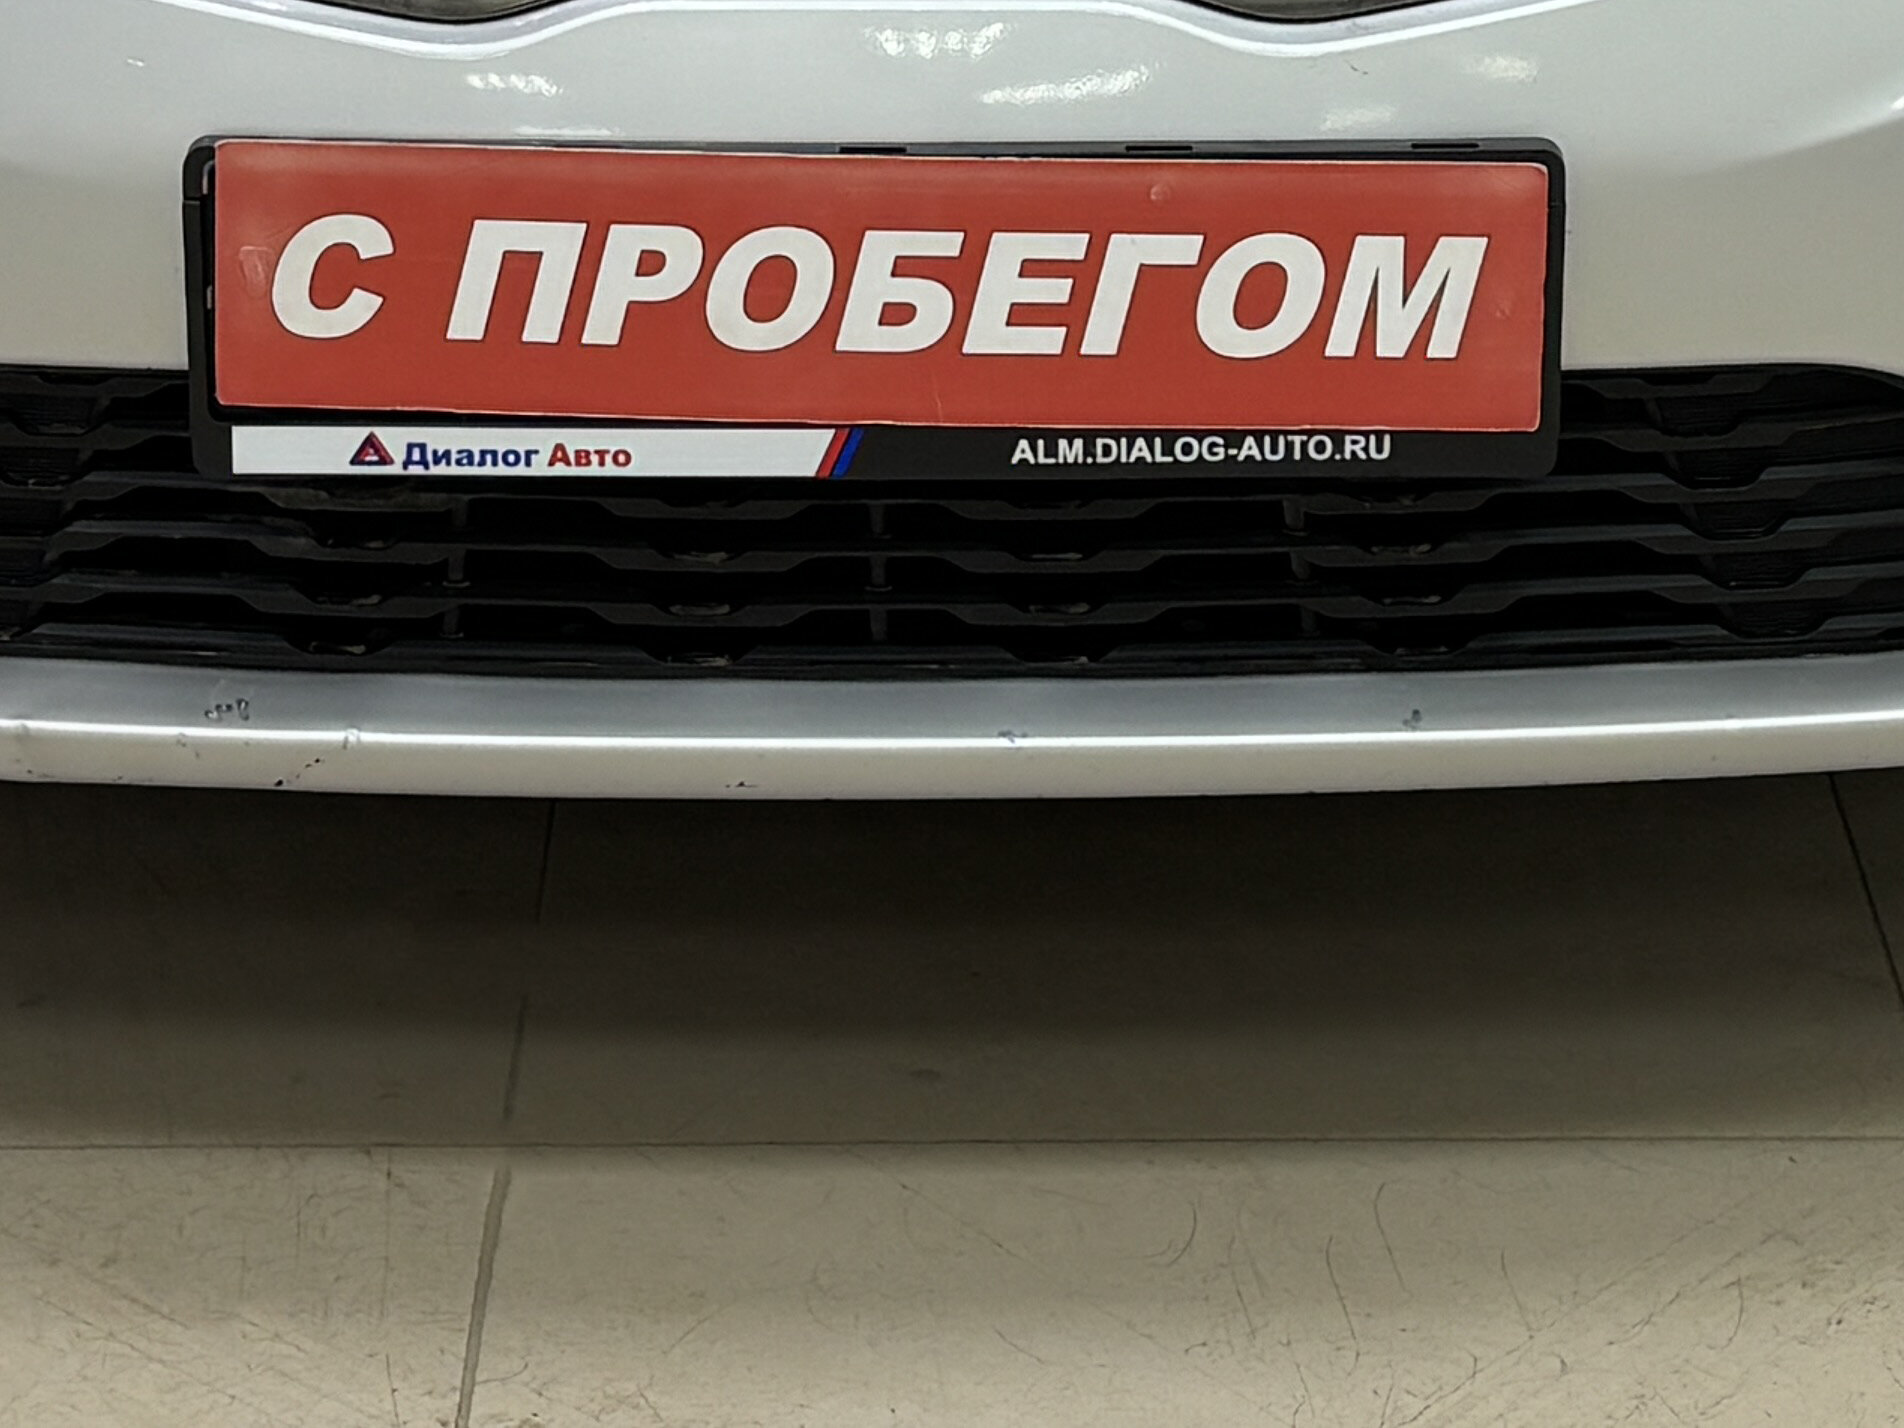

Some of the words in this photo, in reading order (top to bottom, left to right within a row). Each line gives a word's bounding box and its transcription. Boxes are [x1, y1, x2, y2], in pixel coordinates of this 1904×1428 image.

[271, 214, 394, 339] С
[446, 218, 1489, 360] ПРОБЕГОМ
[402, 442, 540, 470] Диалог
[547, 443, 632, 467] Авто
[1010, 434, 1392, 465] ALM.DIALOG-AUTO.RU
